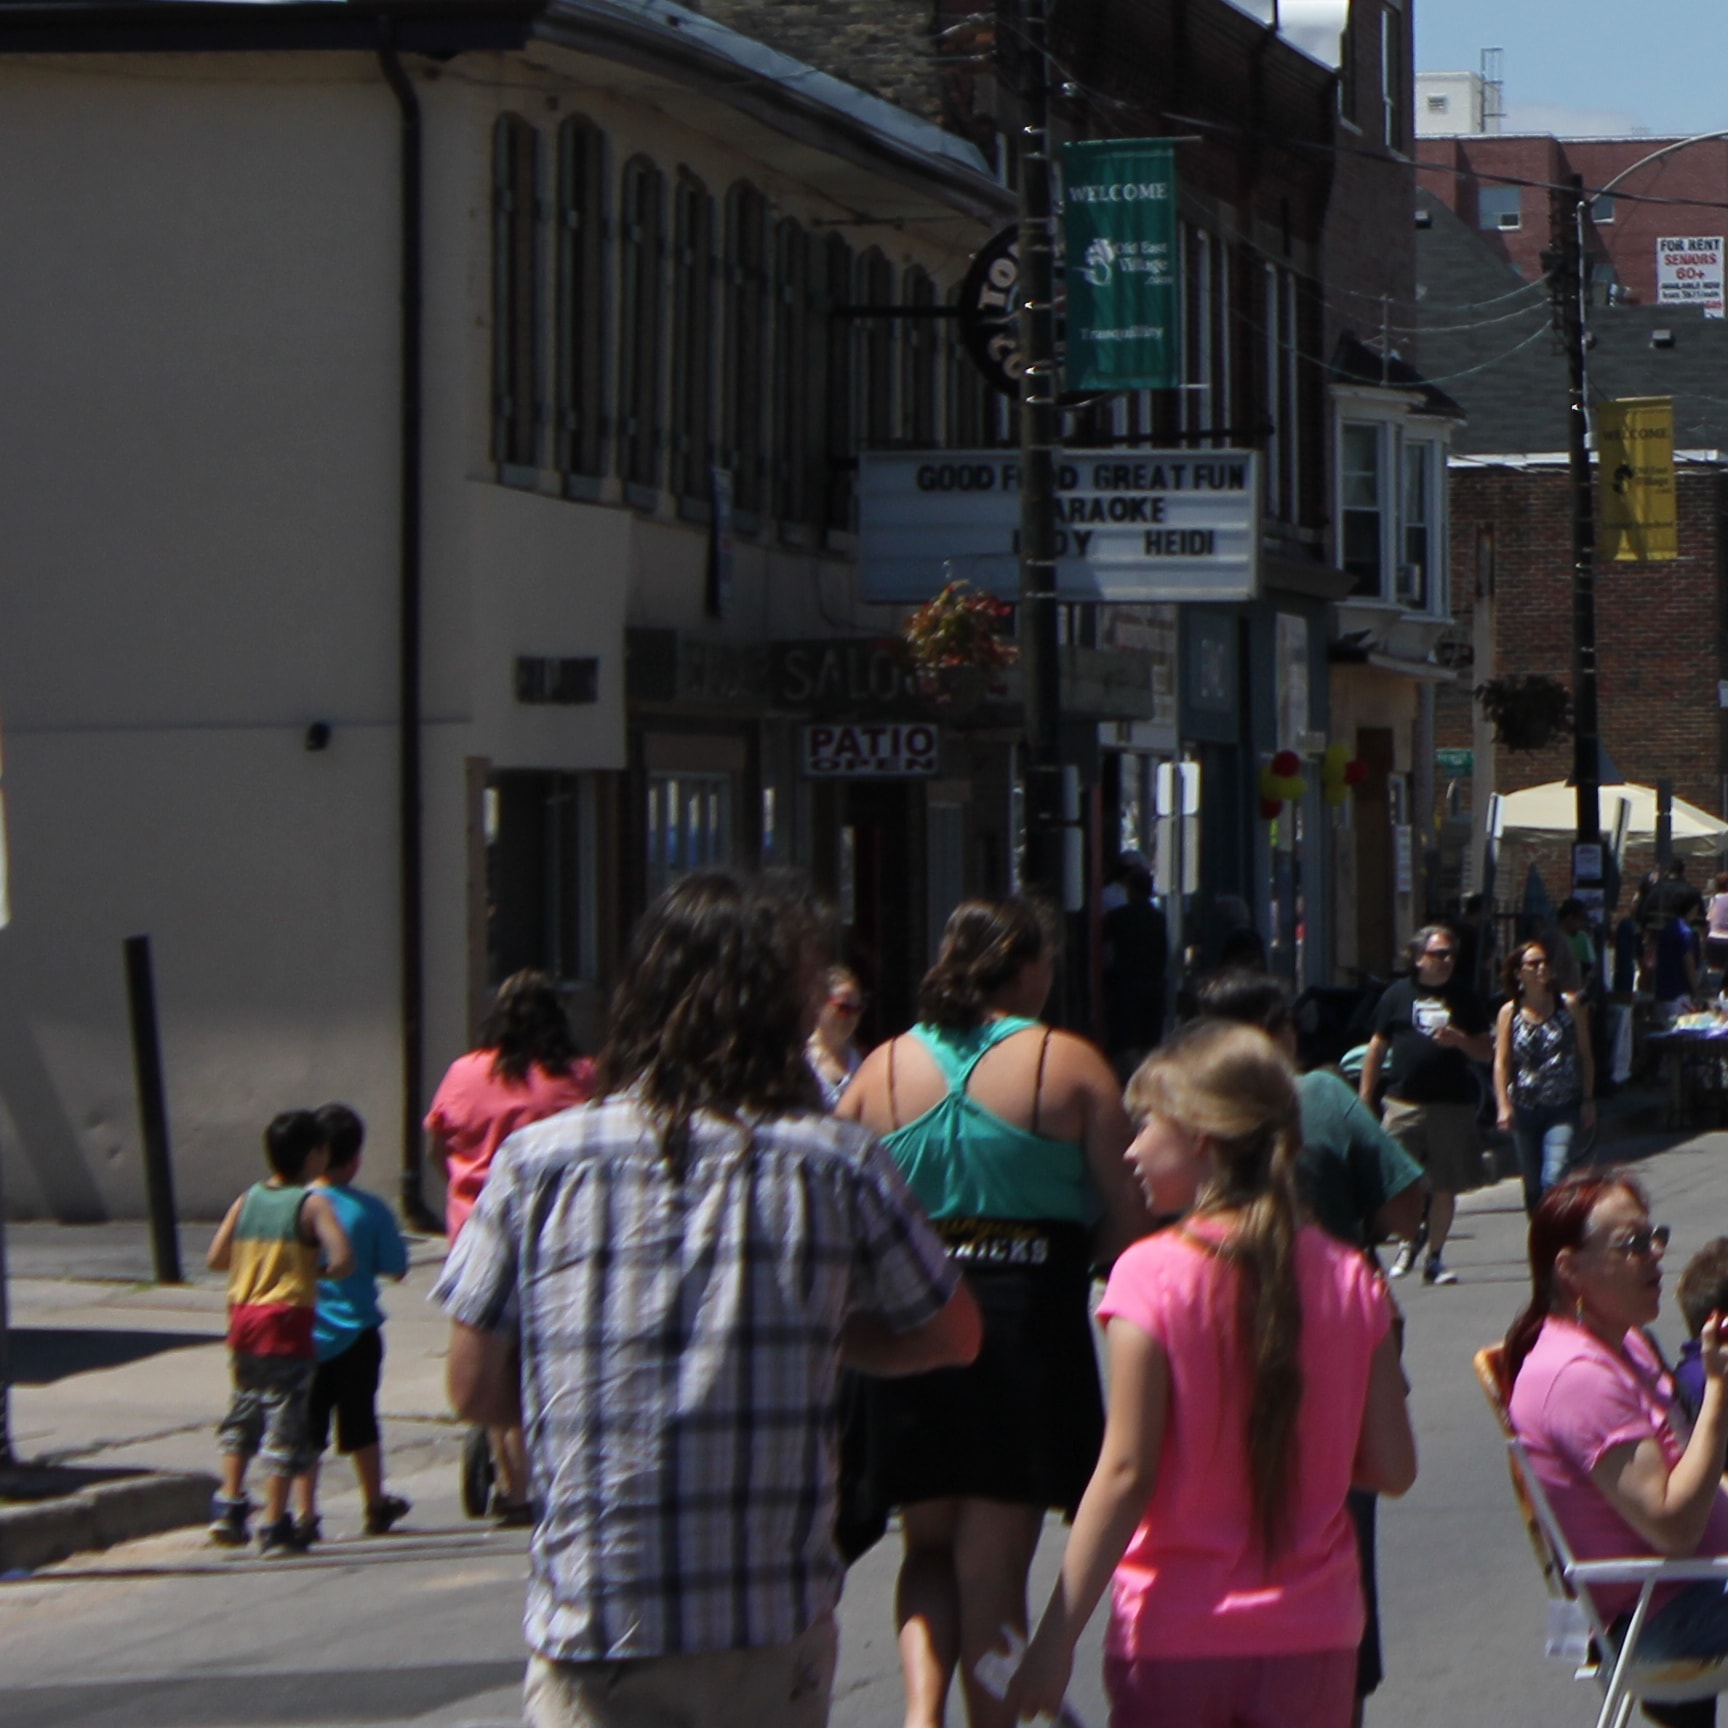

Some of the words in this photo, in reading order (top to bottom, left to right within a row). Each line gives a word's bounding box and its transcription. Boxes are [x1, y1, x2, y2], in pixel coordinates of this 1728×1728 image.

[1069, 182, 1168, 203] WELCOME
[1660, 239, 1684, 252] FOR
[1688, 238, 1720, 251] RENT
[1119, 257, 1169, 274] Village
[1664, 253, 1717, 266] SENIORS
[1676, 267, 1705, 280] 60+
[916, 465, 995, 492] GOOD
[1001, 465, 1078, 492] FD
[1093, 464, 1187, 491] GREAT
[1193, 464, 1246, 490] FUN
[1052, 497, 1166, 523] ARAOKE
[1145, 529, 1215, 556] HEIDI
[810, 726, 934, 757] PATIO
